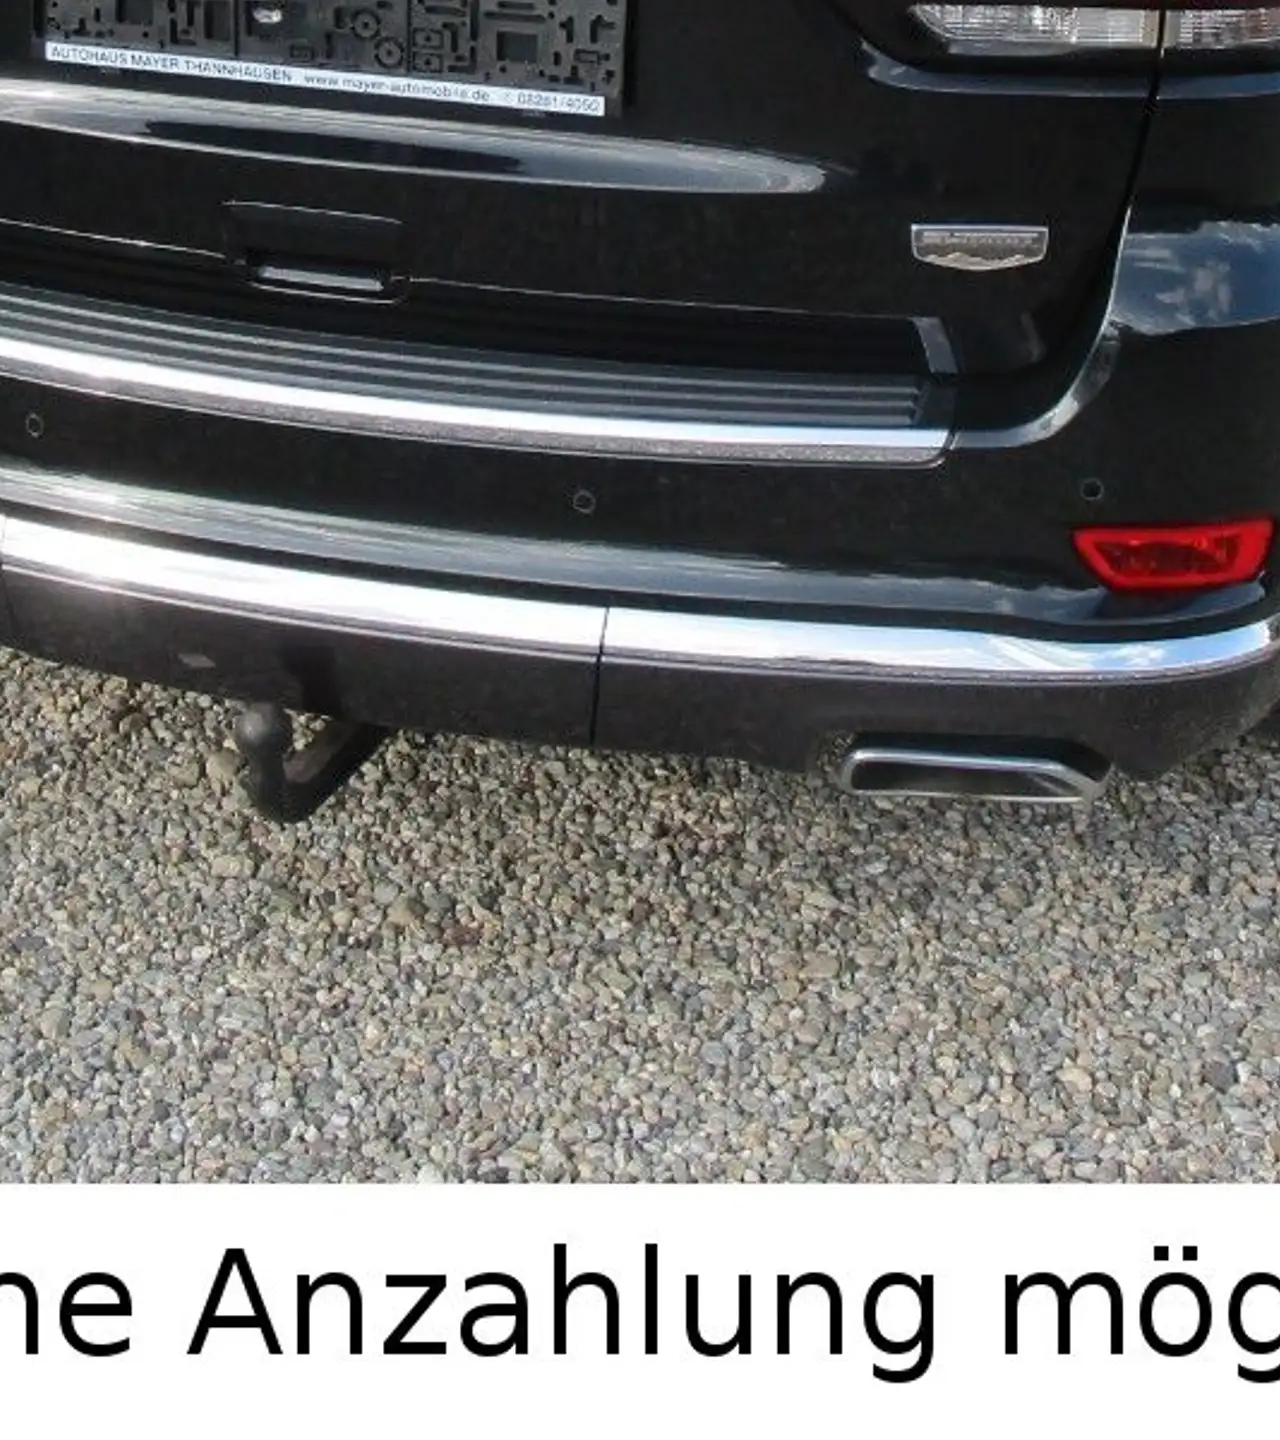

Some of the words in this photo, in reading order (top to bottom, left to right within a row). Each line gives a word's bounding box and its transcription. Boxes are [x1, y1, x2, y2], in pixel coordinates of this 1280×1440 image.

[51, 46, 129, 66] AUTOHAUS
[131, 54, 179, 70] MAYER
[184, 60, 292, 83] THANNHAUSEN
[303, 75, 491, 103] www.mayer-automobile.de
